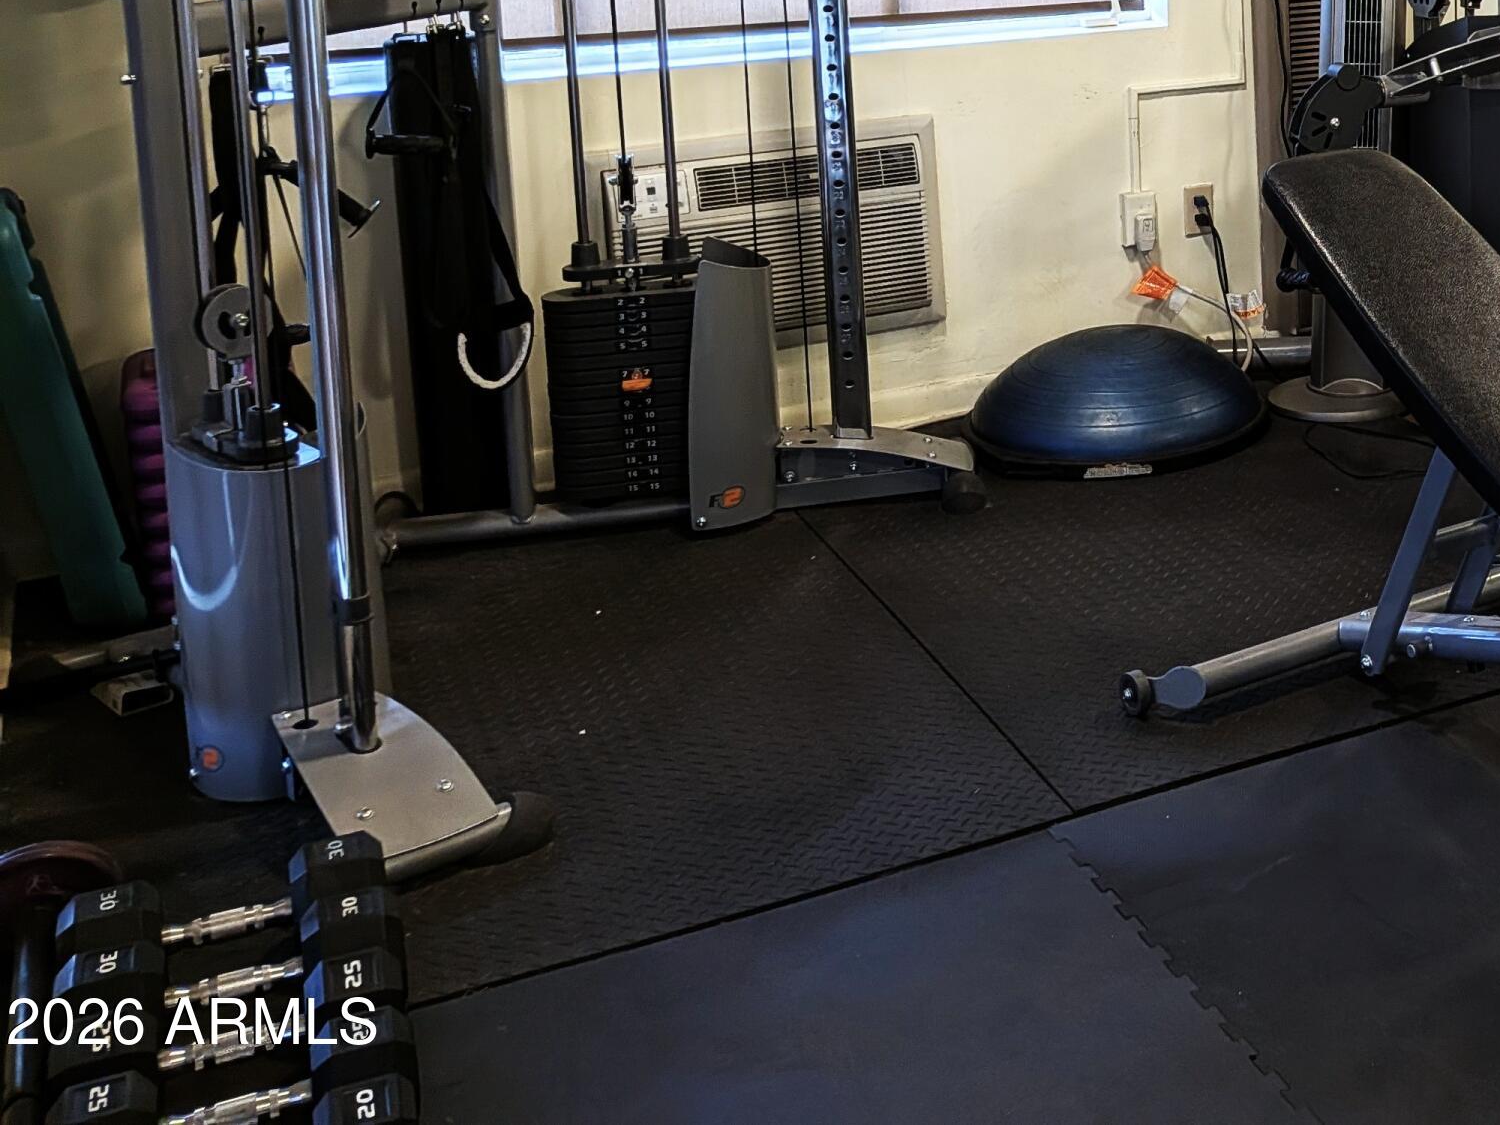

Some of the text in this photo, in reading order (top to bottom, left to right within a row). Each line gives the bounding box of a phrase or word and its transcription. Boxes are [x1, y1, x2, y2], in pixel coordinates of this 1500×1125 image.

[620, 340, 648, 350] 5 5
[327, 840, 344, 860] 30
[100, 890, 117, 911] 30
[341, 896, 359, 918] 30
[99, 950, 118, 974] 30
[343, 959, 362, 989] 25
[88, 1084, 110, 1112] 25
[356, 1088, 376, 1120] 20
